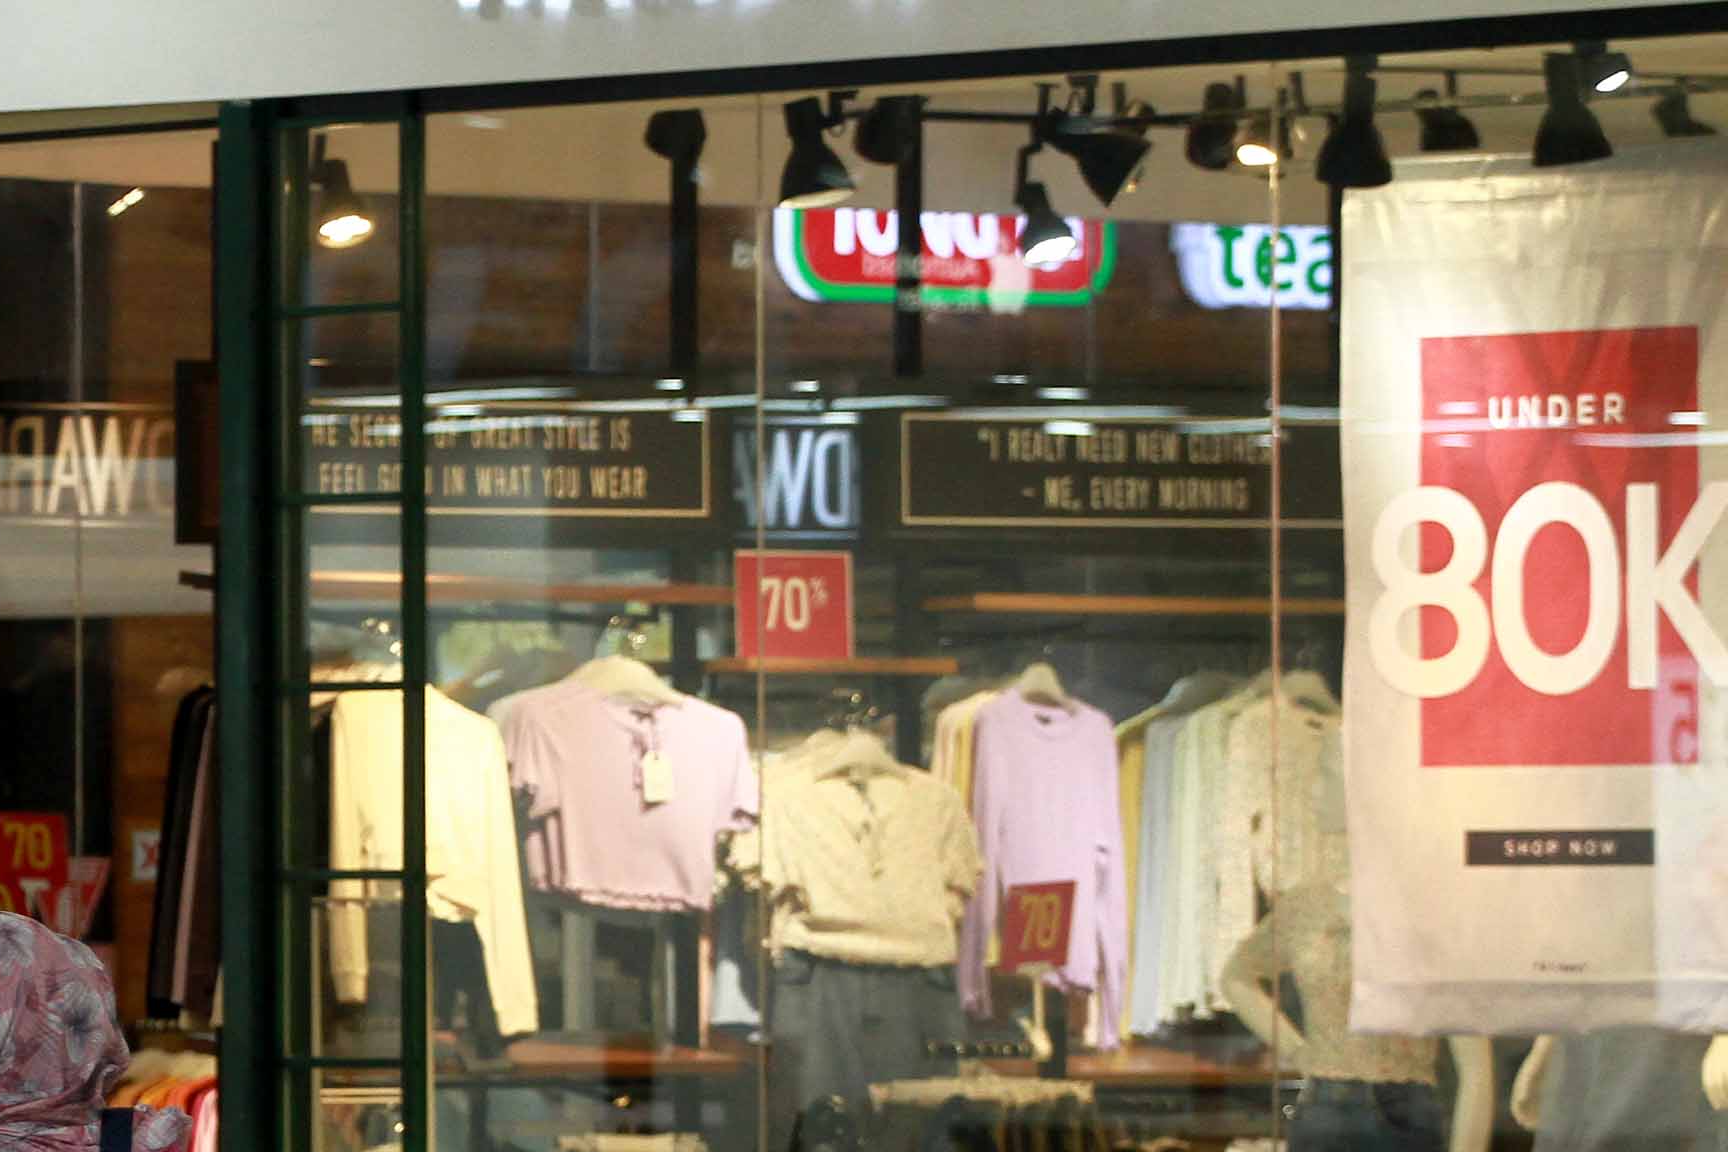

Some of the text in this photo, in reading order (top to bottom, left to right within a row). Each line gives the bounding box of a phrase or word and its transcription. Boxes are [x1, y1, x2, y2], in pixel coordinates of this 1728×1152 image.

[1487, 393, 1626, 429] UNDER
[542, 416, 601, 450] STYLE
[609, 417, 632, 451] IS
[443, 464, 467, 497] IN
[475, 464, 532, 497] WHAT
[543, 465, 581, 499] YOU
[590, 465, 649, 499] WEAR
[1090, 477, 1152, 512] EVERY
[1158, 478, 1249, 512] MORNING
[760, 576, 828, 632] 70%
[1370, 481, 1728, 699] 80K
[3, 821, 53, 871] 70
[1503, 838, 1617, 859] SHOP NOW
[1020, 892, 1063, 948] 70
